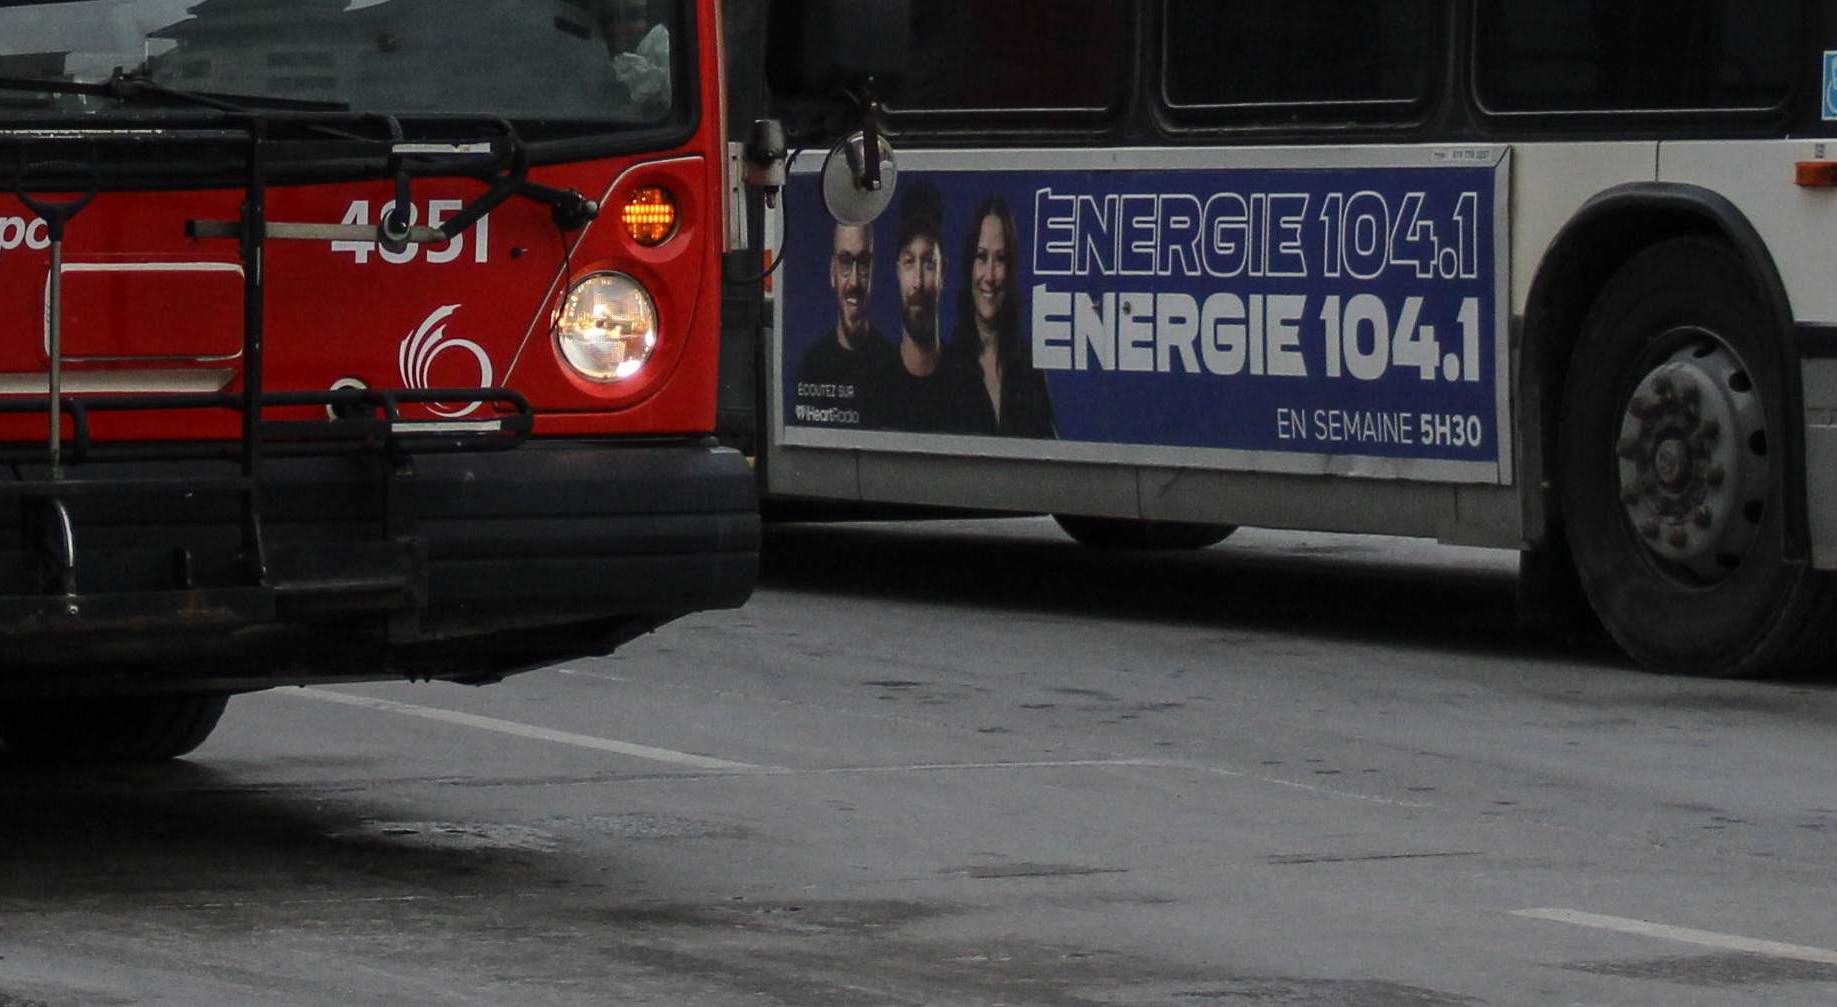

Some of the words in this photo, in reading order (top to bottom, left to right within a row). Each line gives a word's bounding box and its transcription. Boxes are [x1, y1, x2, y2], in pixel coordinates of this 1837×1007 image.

[1319, 190, 1478, 280] 104.1
[1319, 293, 1480, 382] 104.1
[1276, 408, 1308, 440] EN
[1314, 410, 1414, 445] SEMAINE
[1419, 415, 1483, 447] 5H30
